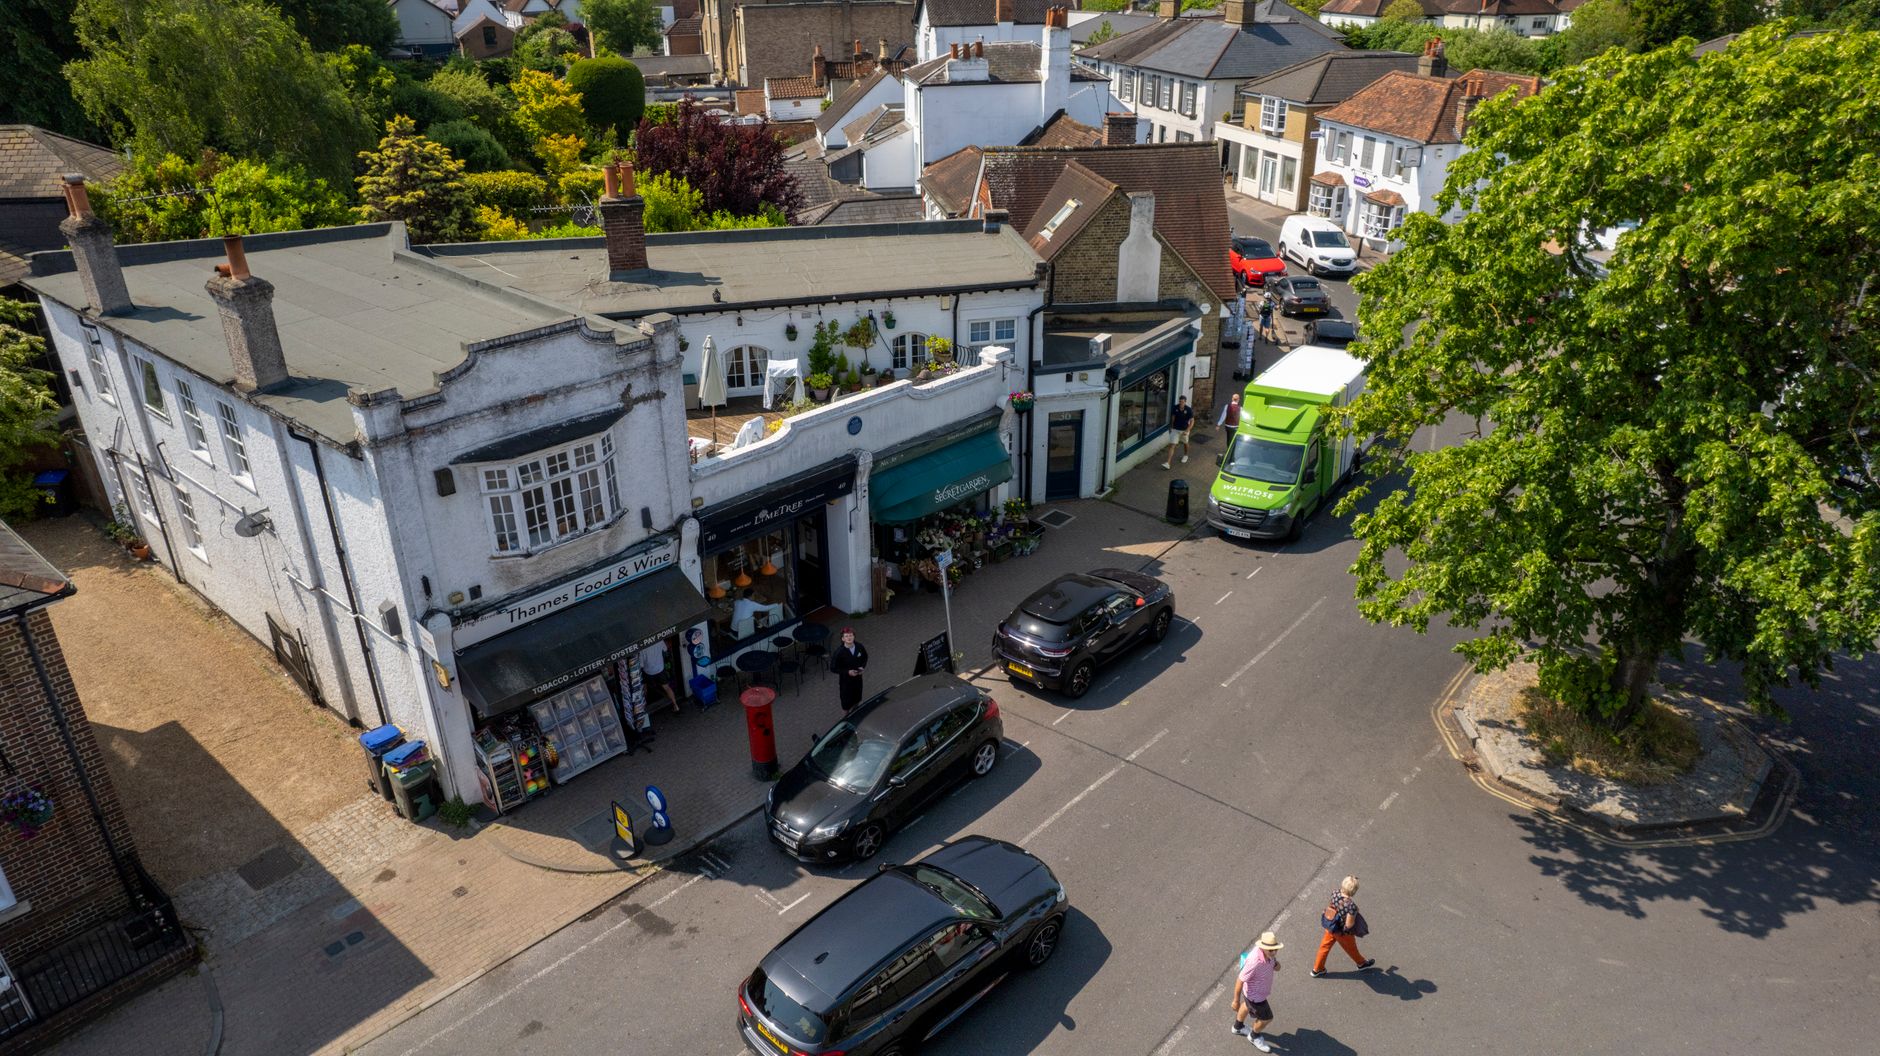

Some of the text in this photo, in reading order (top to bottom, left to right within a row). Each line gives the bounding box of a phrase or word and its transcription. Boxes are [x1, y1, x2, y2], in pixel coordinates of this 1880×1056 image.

[1223, 485, 1274, 499] WAITROSE
[506, 552, 671, 623] Thames Food & Wine
[532, 674, 569, 695] TOBACCO
[574, 658, 606, 677] LOTTERY
[611, 643, 639, 660] OYSTER
[643, 635, 656, 646] PAY
[657, 626, 677, 640] POINT
